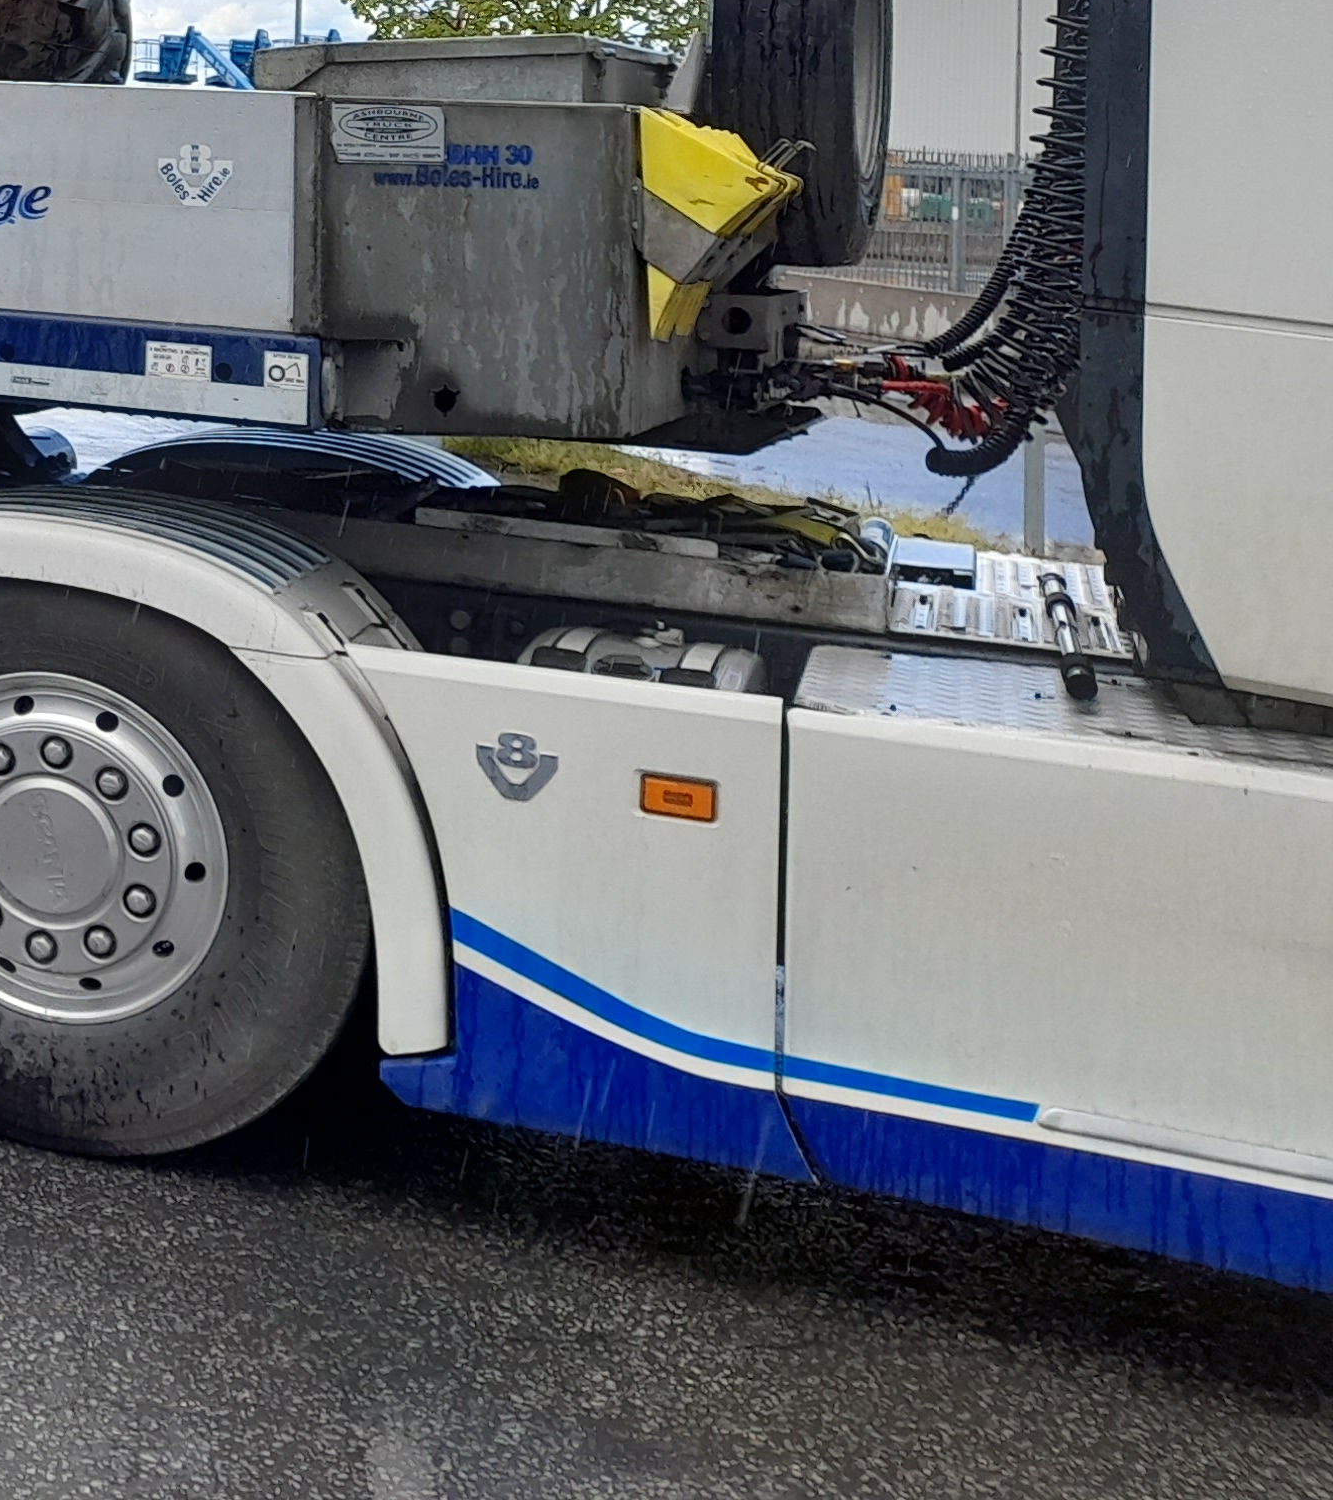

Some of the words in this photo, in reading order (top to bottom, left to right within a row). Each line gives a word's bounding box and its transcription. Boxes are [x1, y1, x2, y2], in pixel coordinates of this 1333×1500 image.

[353, 109, 424, 120] ASHBOURNE
[364, 131, 412, 140] CENTRE
[505, 144, 533, 166] 30
